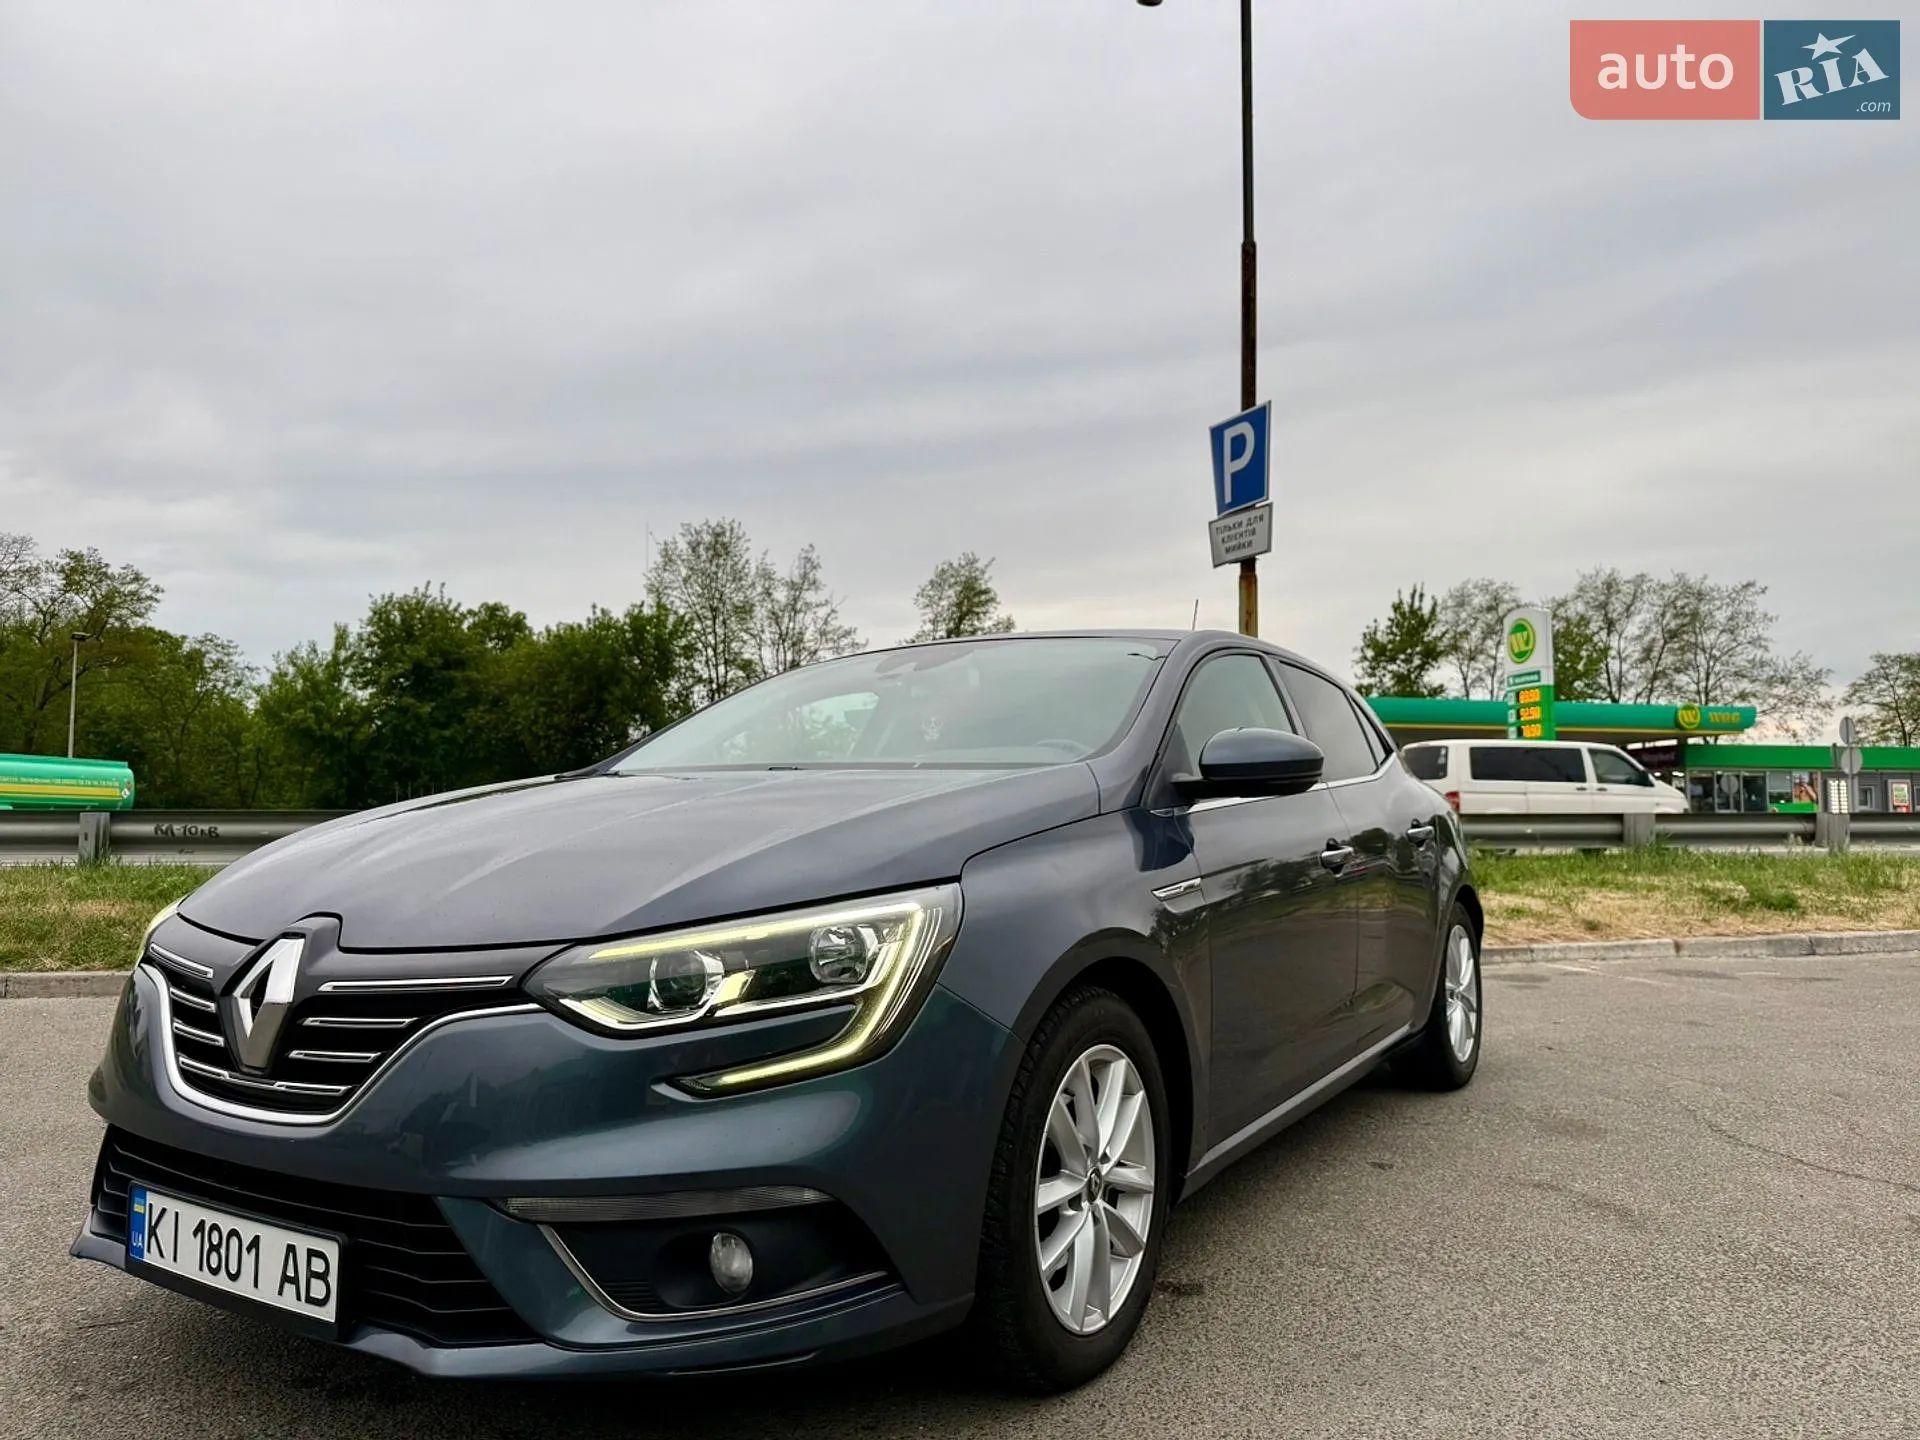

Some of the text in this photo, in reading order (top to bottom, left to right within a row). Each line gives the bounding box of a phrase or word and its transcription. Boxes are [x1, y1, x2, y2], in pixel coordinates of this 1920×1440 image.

[1223, 420, 1256, 505] P
[1215, 514, 1264, 536] ТІЛЬКИ ДЛЯ
[1224, 540, 1253, 554] МИЙКИ
[131, 1230, 144, 1249] UA
[146, 1201, 332, 1307] KI 1801 AB
